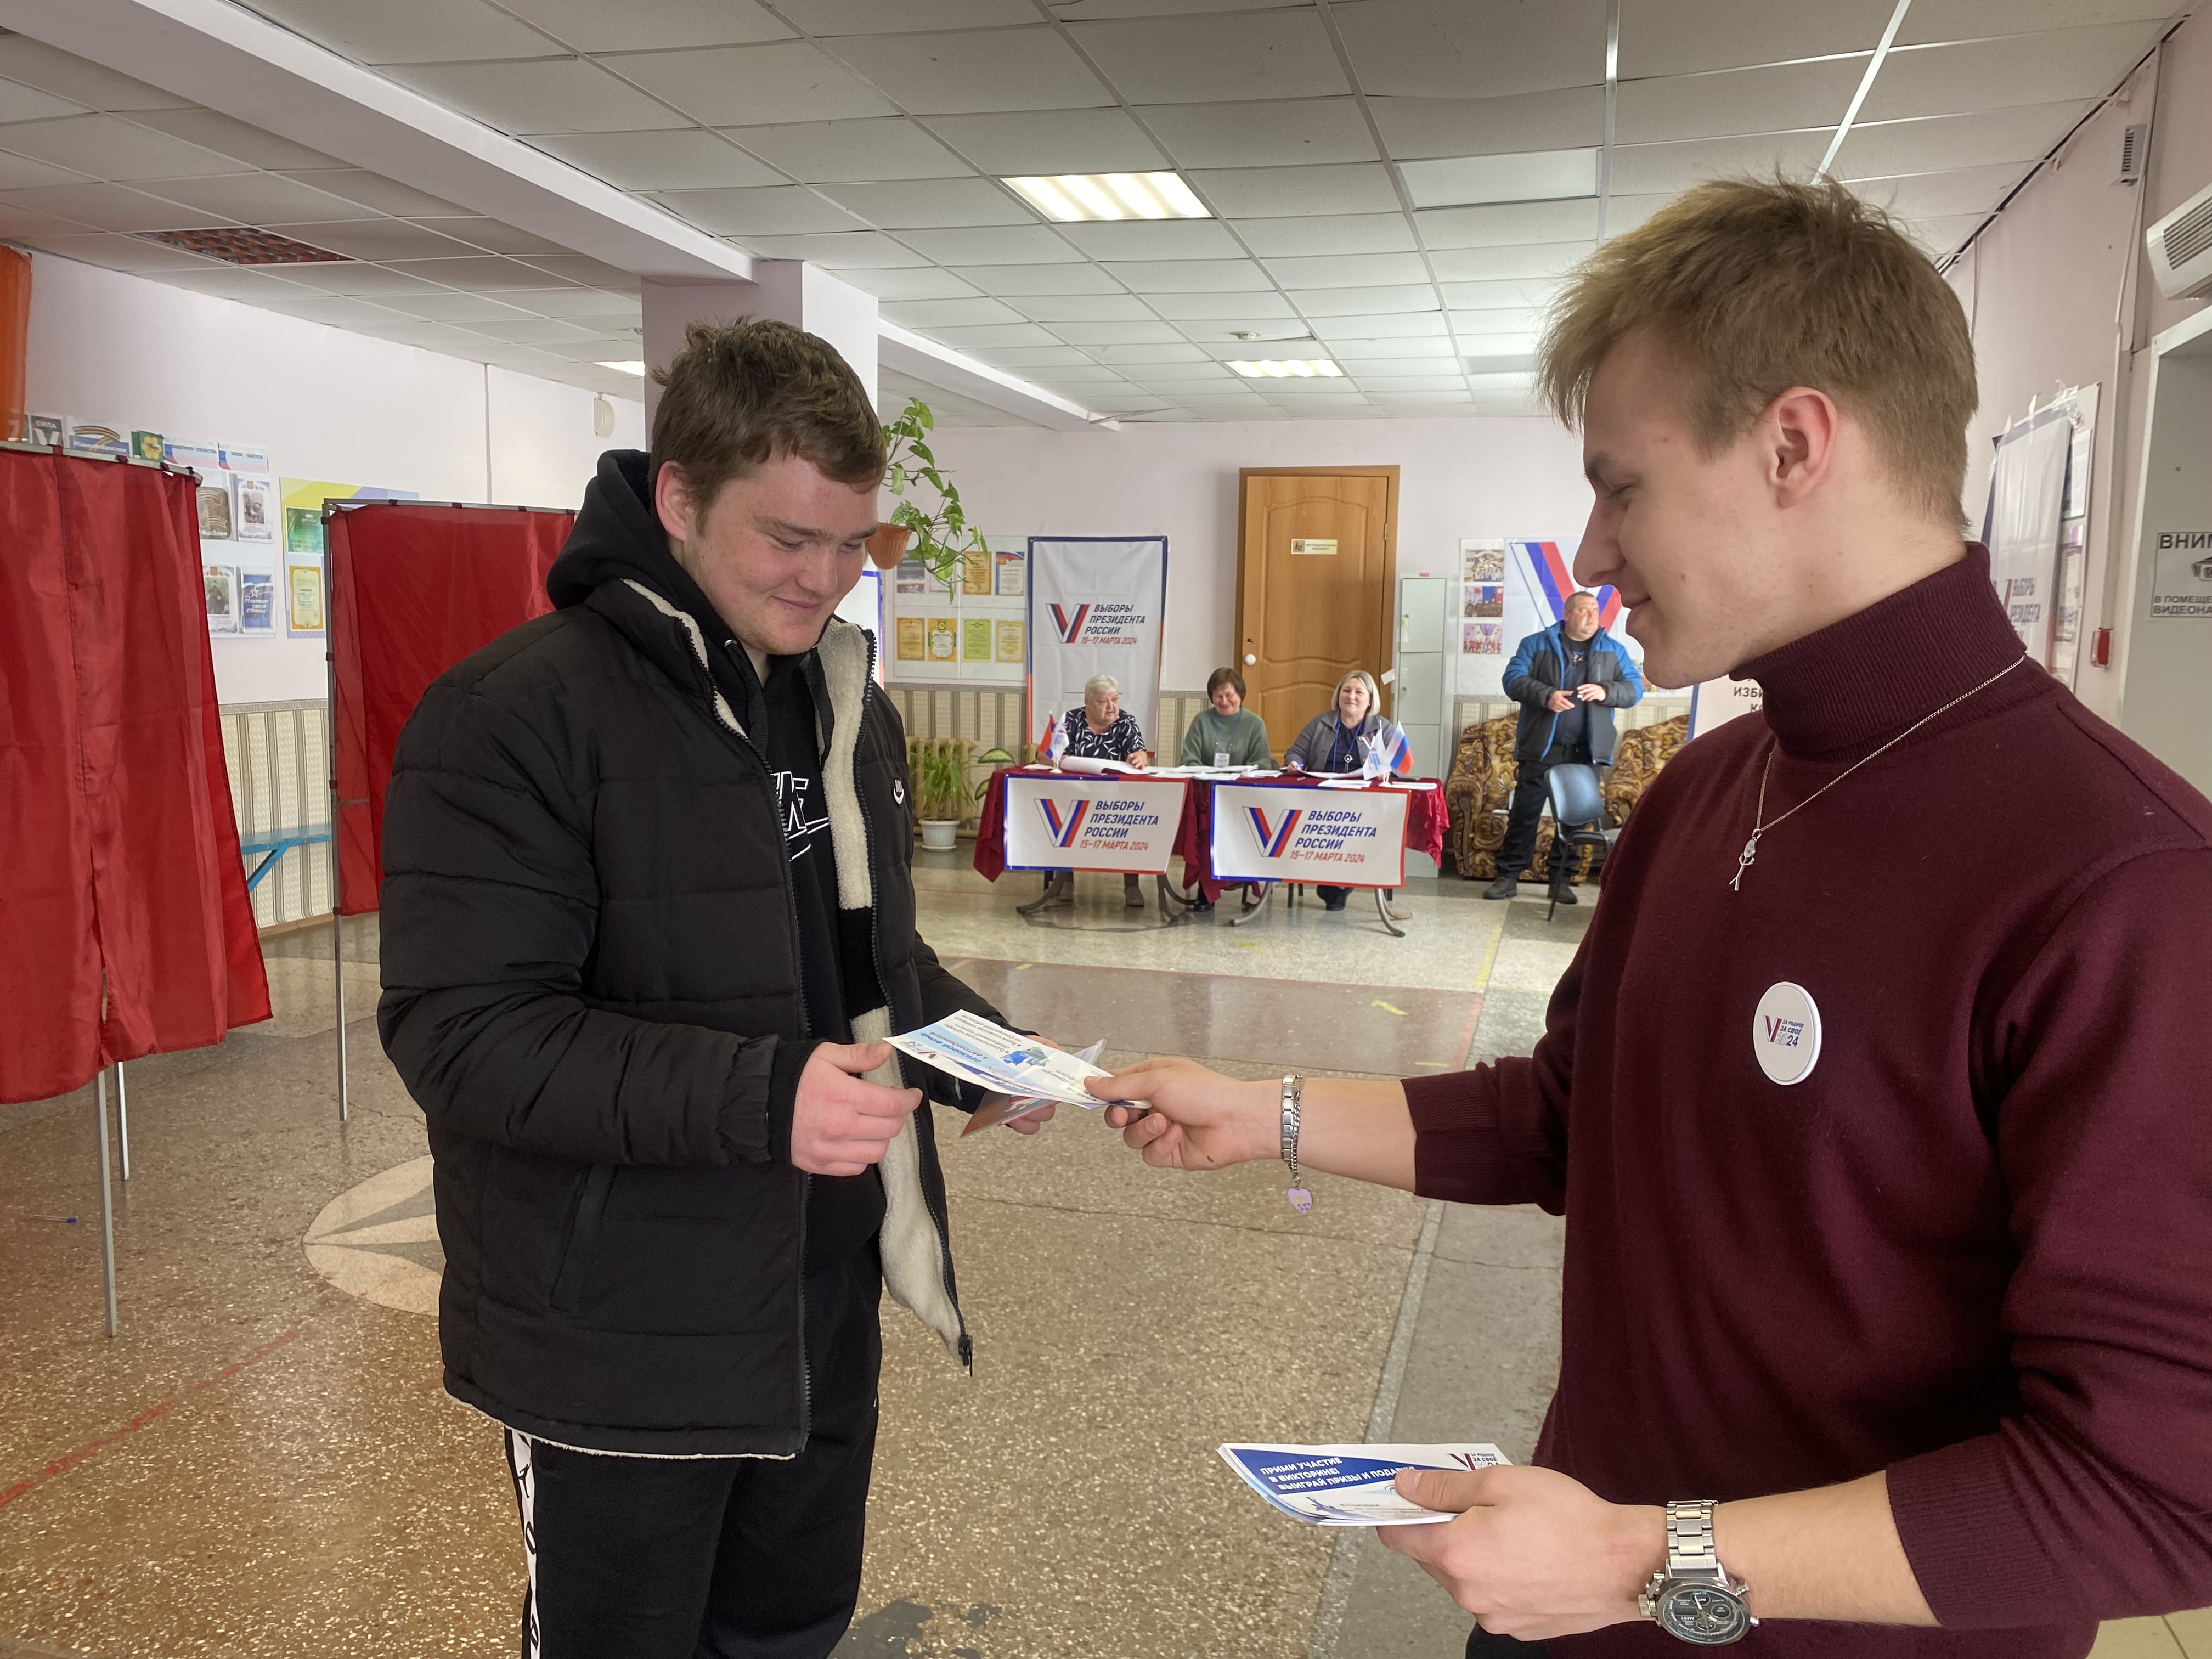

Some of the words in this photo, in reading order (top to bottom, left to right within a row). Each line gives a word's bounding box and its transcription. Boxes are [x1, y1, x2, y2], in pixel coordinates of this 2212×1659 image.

[36, 420, 57, 429] СИЛА
[1094, 604, 1133, 612] ВЫБОРЫ
[1089, 615, 1146, 624] ПРЕЗИДЕНТА
[1095, 800, 1145, 811] ВЫБОРЫ
[1090, 814, 1159, 826] ПРЕЗИДЕНТА
[1308, 810, 1362, 822] ВЫБОРЫ
[1084, 827, 1129, 838] РОССИИ
[1301, 824, 1377, 838] ПРЕЗИДЕНТА
[1102, 840, 1128, 850] МАРТА
[1130, 842, 1149, 850] 2024
[1295, 838, 1344, 850] РОССИИ
[1314, 852, 1342, 862] МАРТА
[1344, 854, 1365, 864] 2024
[921, 1032, 943, 1045] ФОНД:
[930, 1032, 983, 1057] АВТОМОБИЛЕЙ
[1776, 1032, 1798, 1047] 2024
[941, 1043, 983, 1063] ПРИЗОВОЙ
[1260, 1463, 1297, 1475] ПРИМИ
[1296, 1457, 1343, 1469] УЧАСТИЕ
[1277, 1467, 1340, 1482] ВИКТОРИНЕ!
[1277, 1477, 1328, 1491] ВЫИГРАЙ
[1325, 1474, 1362, 1485] ПРИЗЫ
